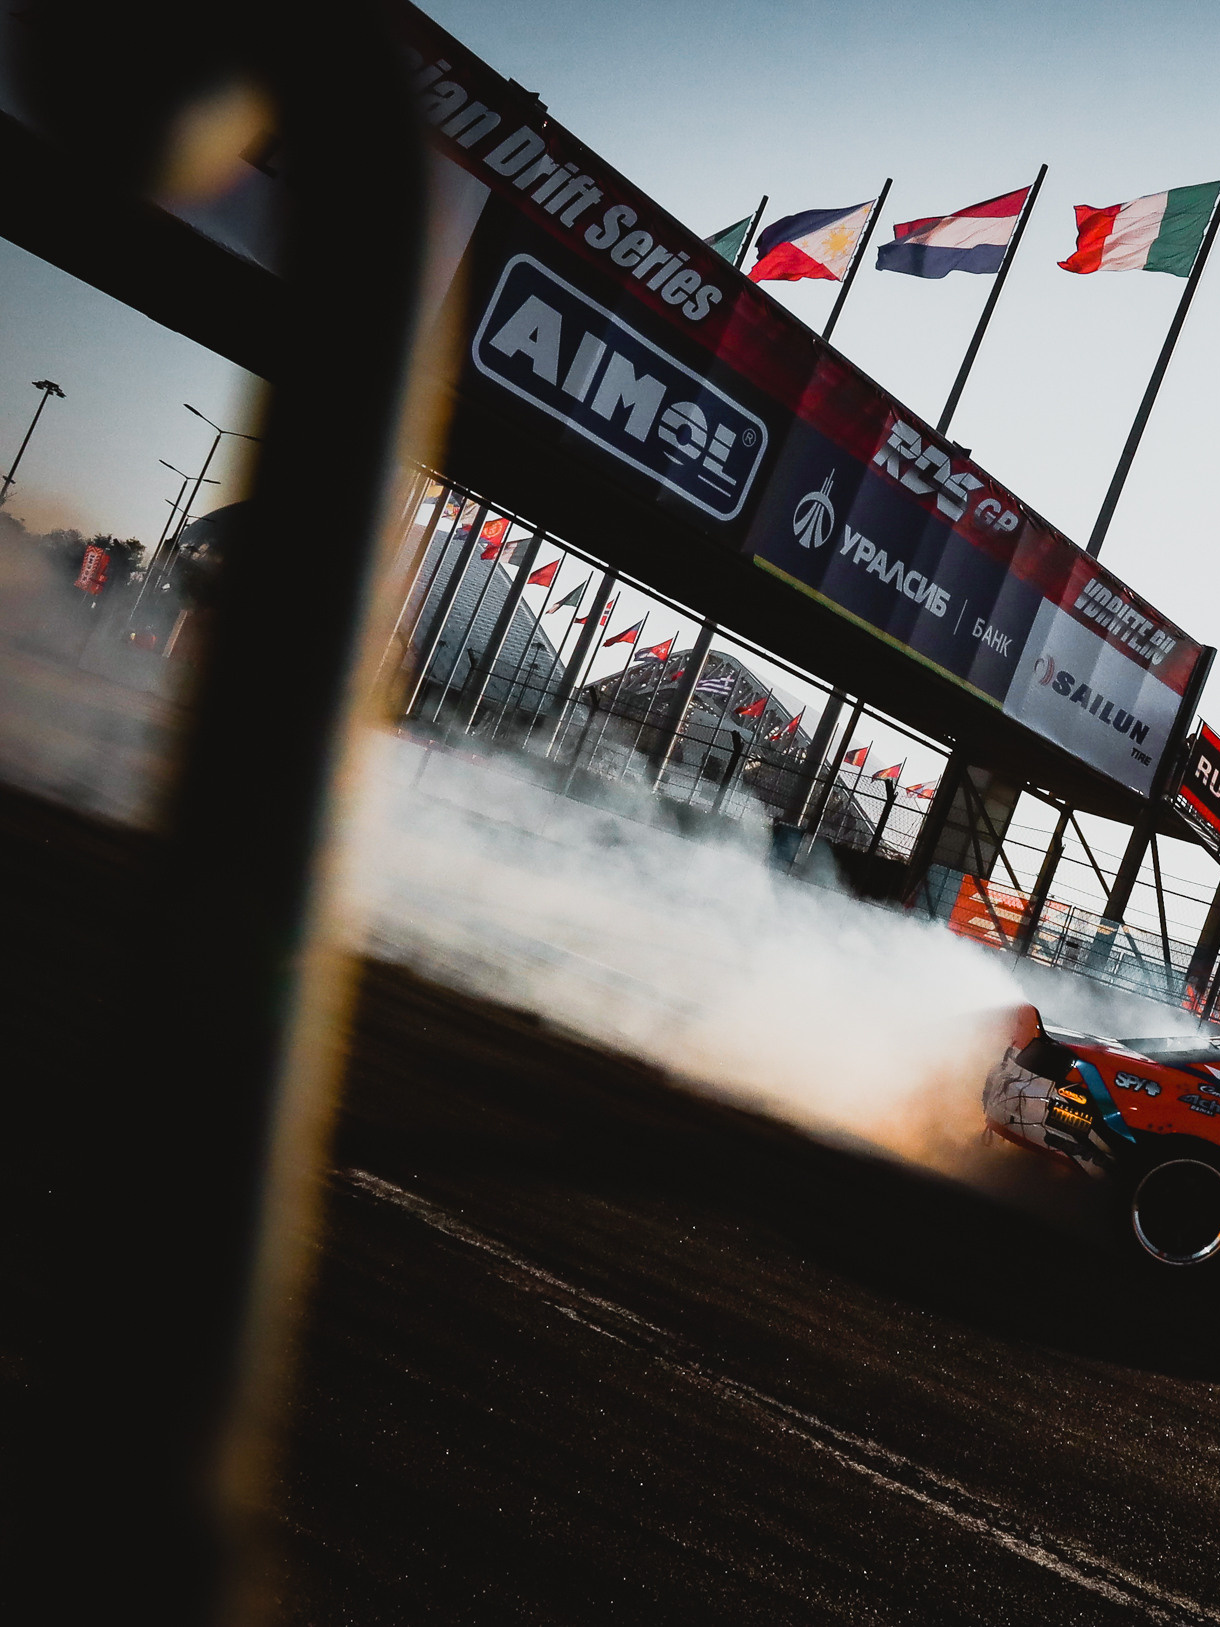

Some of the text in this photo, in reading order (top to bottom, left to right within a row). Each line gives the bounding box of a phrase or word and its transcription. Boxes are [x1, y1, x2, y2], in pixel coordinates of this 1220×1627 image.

[482, 125, 604, 229] Drift
[584, 204, 723, 321] Series
[488, 294, 737, 498] AIMOL
[872, 418, 1019, 534] RDS GP
[839, 523, 951, 618] УРАЛСИБ
[972, 617, 1013, 658] БАНК
[1052, 669, 1150, 745] SAILUN
[1131, 746, 1152, 767] TIRE
